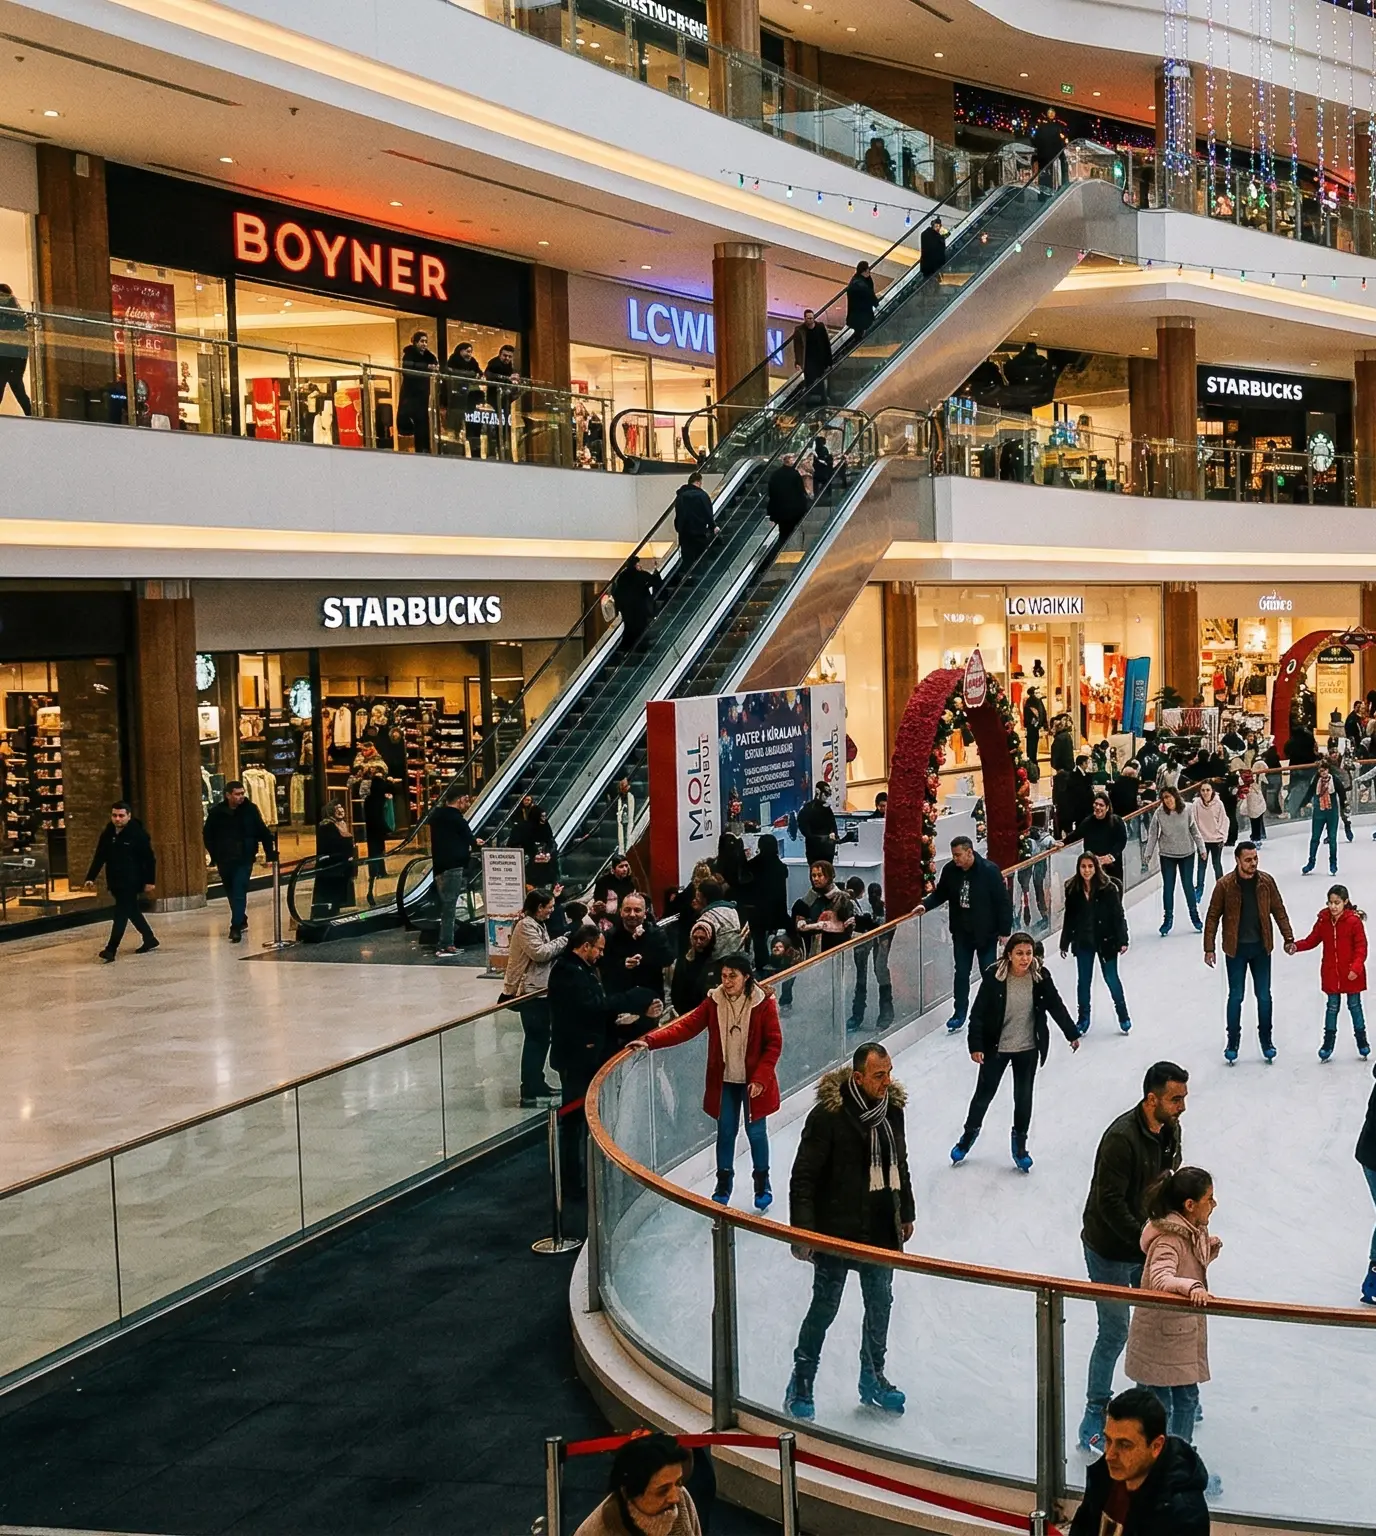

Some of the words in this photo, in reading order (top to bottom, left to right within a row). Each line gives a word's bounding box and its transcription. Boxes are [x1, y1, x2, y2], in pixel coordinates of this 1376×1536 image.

[234, 211, 448, 301] BOYNER
[1206, 376, 1304, 401] STARBUCKS
[323, 596, 502, 629] STARBUCKS
